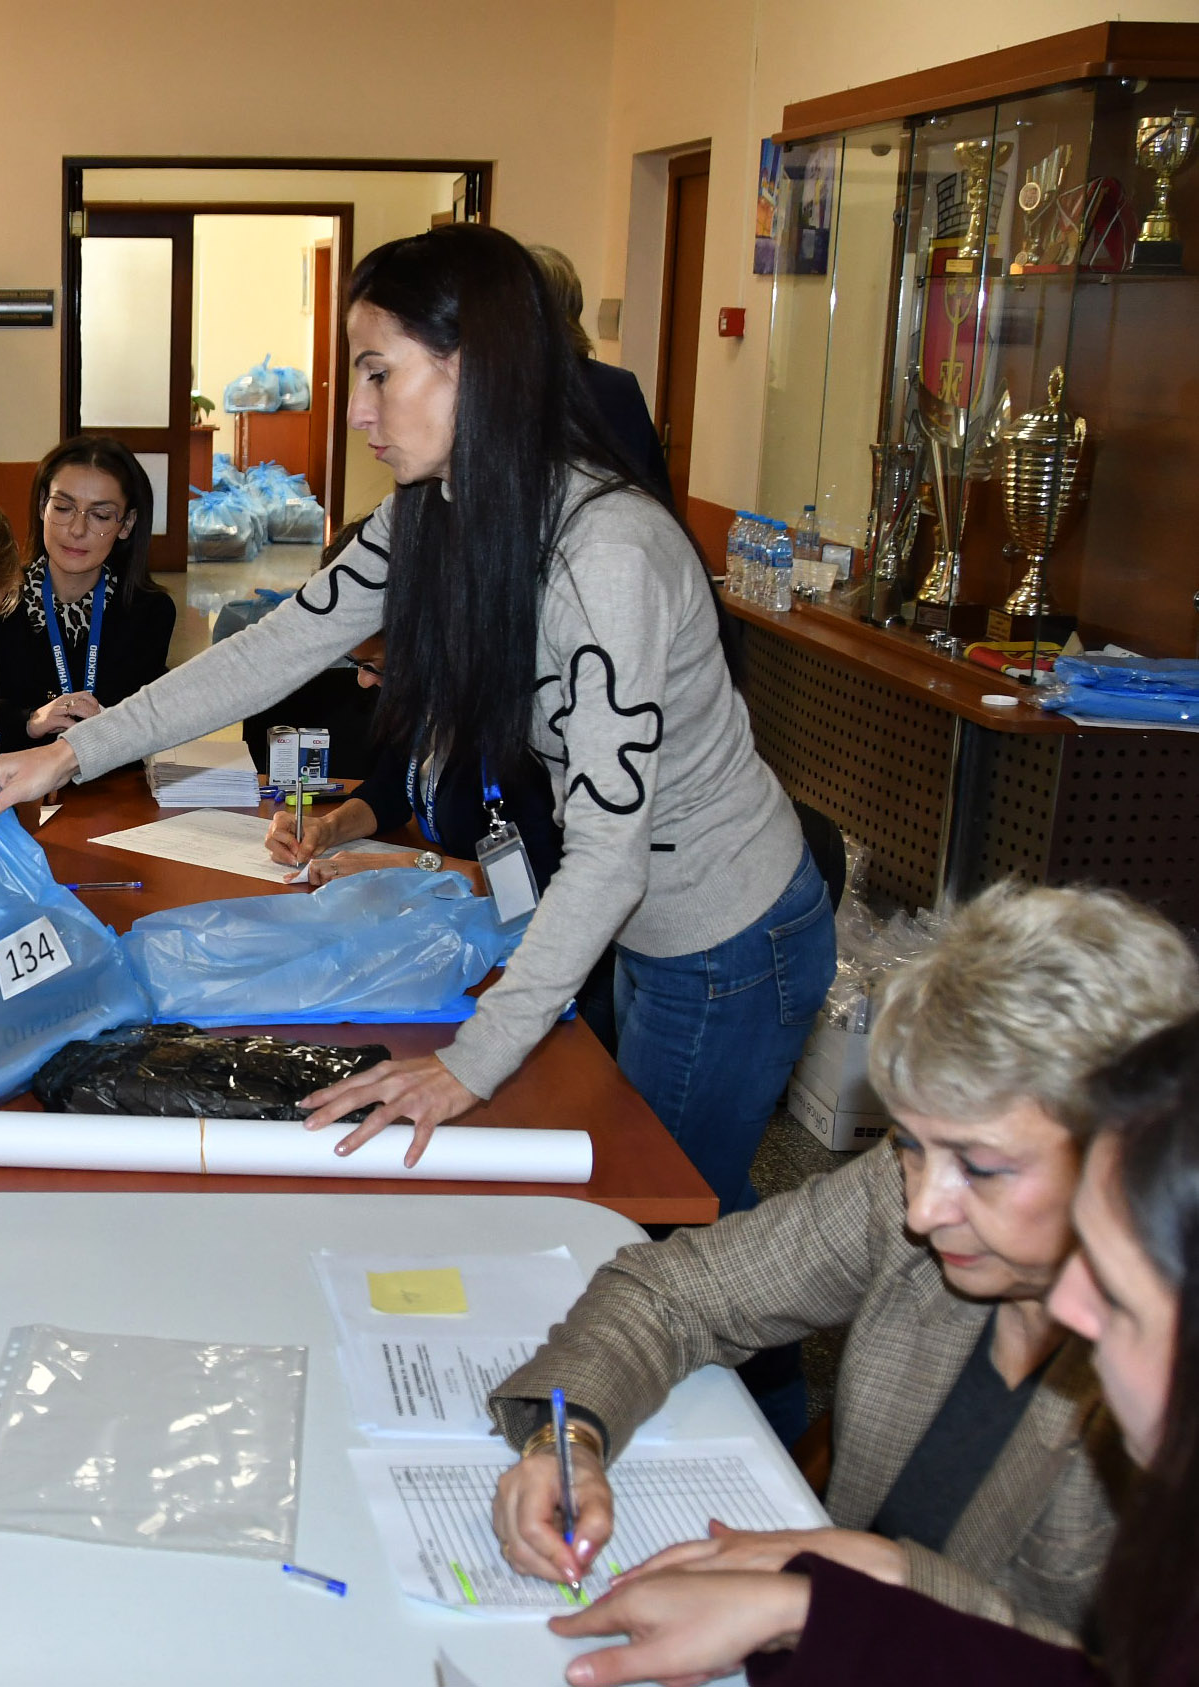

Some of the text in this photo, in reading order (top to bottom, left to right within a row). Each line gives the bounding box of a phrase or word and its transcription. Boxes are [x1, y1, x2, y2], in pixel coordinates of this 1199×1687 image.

[53, 644, 68, 685] ОБЩИНА
[86, 644, 98, 687] ХАСКОВО
[6, 932, 55, 982] 134
